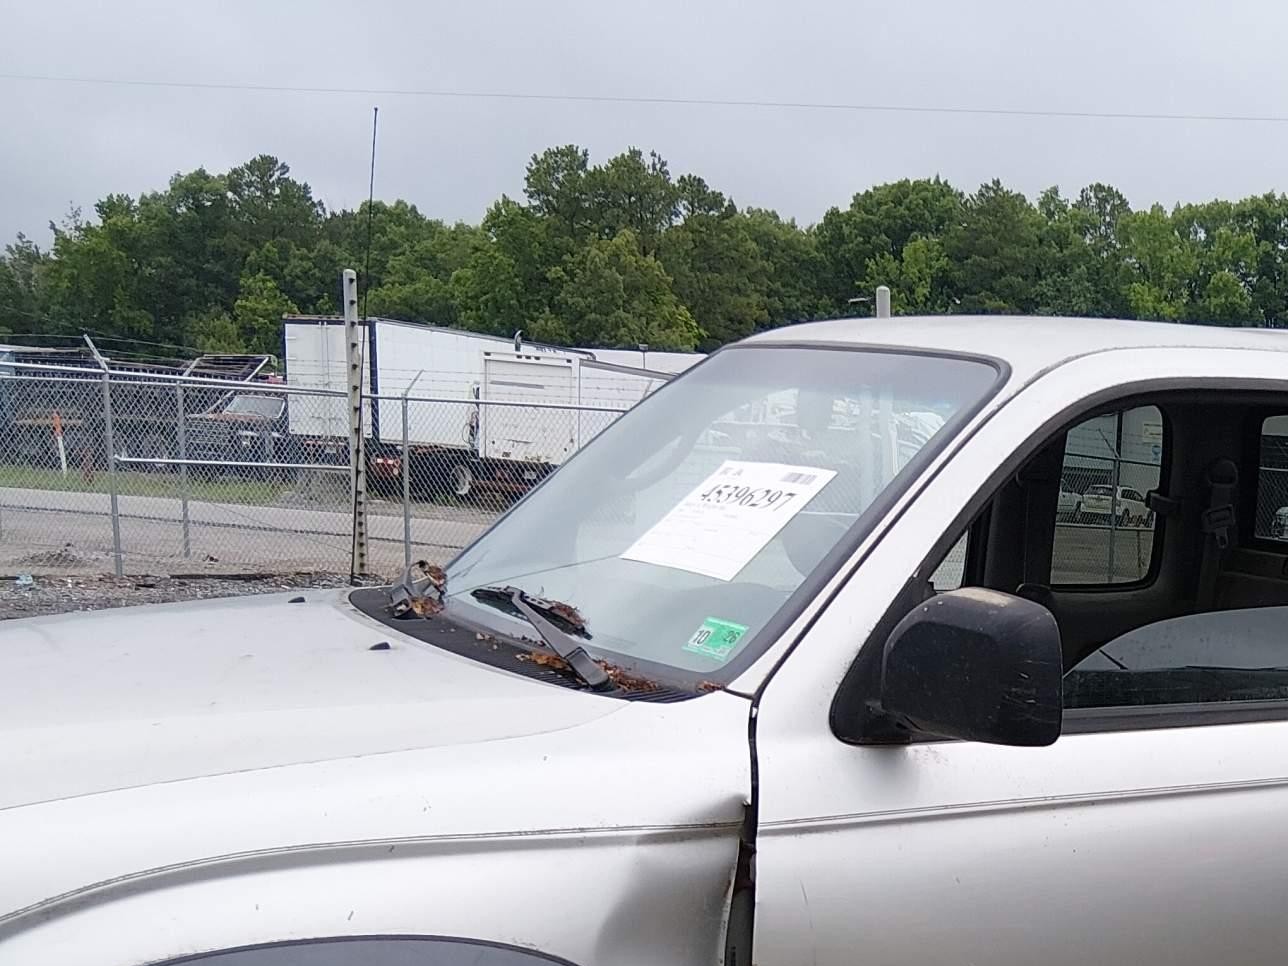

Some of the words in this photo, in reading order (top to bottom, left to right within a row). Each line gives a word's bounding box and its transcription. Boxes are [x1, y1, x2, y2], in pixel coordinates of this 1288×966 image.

[701, 484, 797, 512] 45396297
[693, 630, 711, 644] 10
[723, 630, 741, 644] 26
